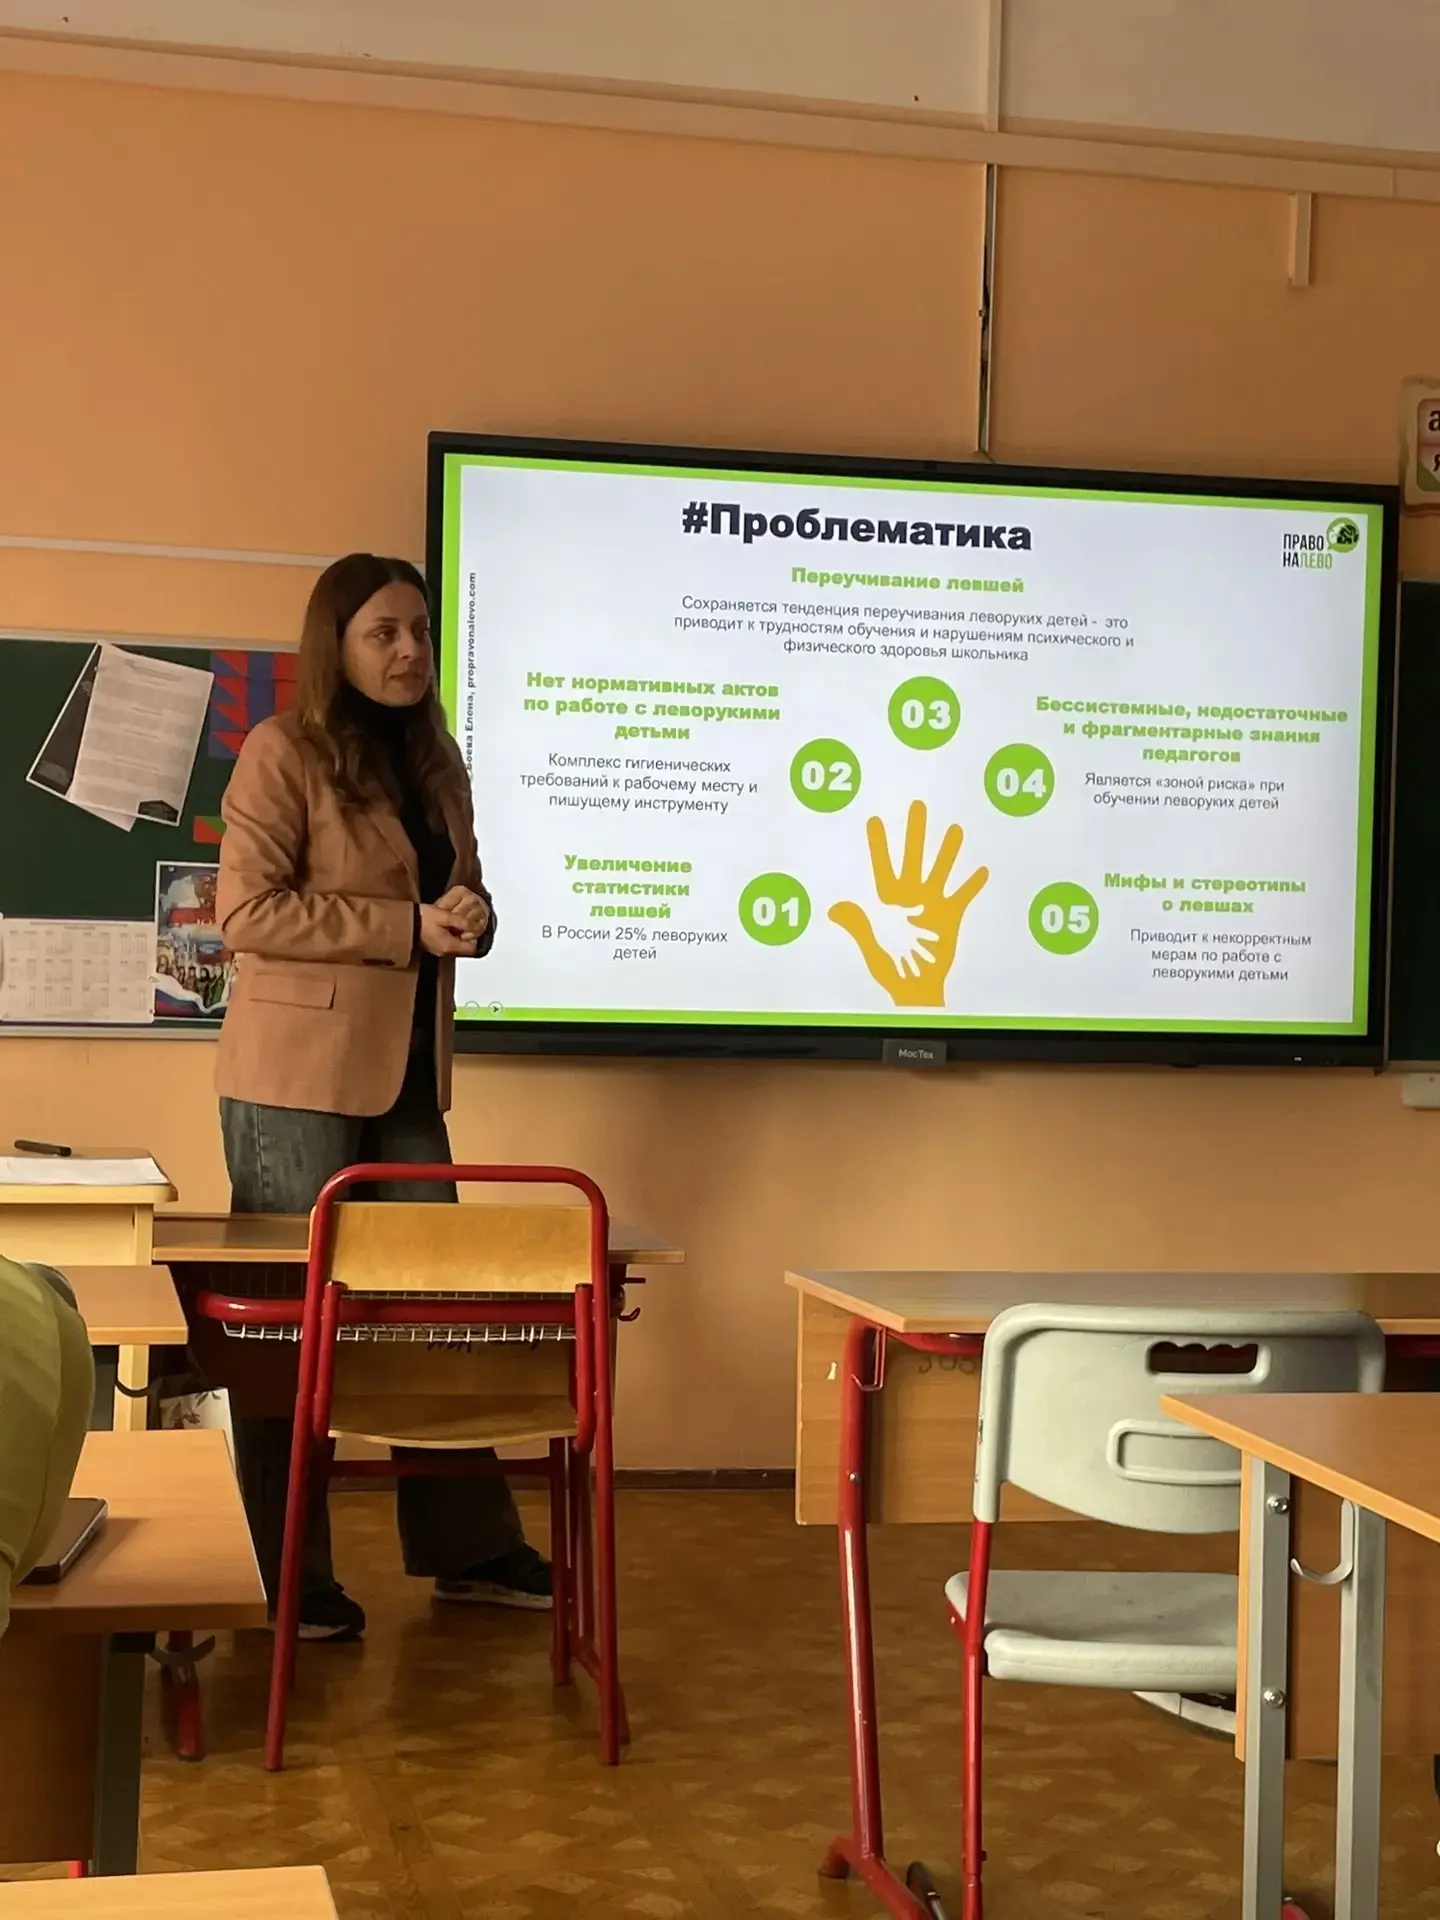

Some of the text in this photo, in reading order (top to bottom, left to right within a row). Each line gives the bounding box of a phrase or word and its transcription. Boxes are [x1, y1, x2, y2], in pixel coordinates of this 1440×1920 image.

[682, 501, 1032, 550] #Проблематика
[1283, 533, 1324, 551] ПРАВО
[1283, 551, 1333, 570] НАЛЕВО
[791, 567, 1024, 593] Переучивание левшей
[682, 596, 777, 614] Сохраняется
[782, 603, 859, 617] тенденция
[864, 606, 965, 622] переучивания
[969, 611, 1042, 627] леворуких
[1047, 614, 1088, 629] детей
[1105, 617, 1128, 629] это
[467, 572, 477, 689] propravonalevo.com
[674, 616, 1134, 647] приводит к трудностям обучения и нарушениям психического и
[784, 639, 1028, 661] физического здоровья школьника
[526, 672, 779, 697] Нет нормативных актов
[465, 691, 476, 732] Елена,
[524, 698, 780, 721] по работе с леворукими
[901, 699, 951, 730] 03
[1036, 696, 1348, 722] Бессистемные, недостаточные
[614, 725, 690, 740] детьми
[1064, 721, 1320, 744] и фрагментарные знания
[549, 753, 731, 772] Комплекс гигиенических
[1142, 748, 1241, 763] педагогов
[520, 773, 758, 795] требований к рабочему месту и
[801, 760, 852, 791] 02
[996, 768, 1046, 798] 04
[1085, 773, 1284, 795] Является «зоной риска» при
[549, 795, 728, 814] пишущему инструменту
[1093, 792, 1279, 811] обучении леворуких детей
[564, 855, 692, 873] Увеличение
[572, 881, 690, 896] статистики
[1104, 873, 1306, 894] Мифы и стереотипы
[590, 903, 671, 919] левшей
[752, 896, 800, 927] 01
[1161, 900, 1254, 913] о левшах
[1041, 904, 1091, 934] 05
[542, 925, 728, 944] В России 25% леворуких
[1130, 928, 1312, 947] Приводит к некорректным
[613, 947, 657, 961] детей
[1151, 949, 1282, 964] мерам по работе с
[1152, 967, 1289, 982] леворукими детьми
